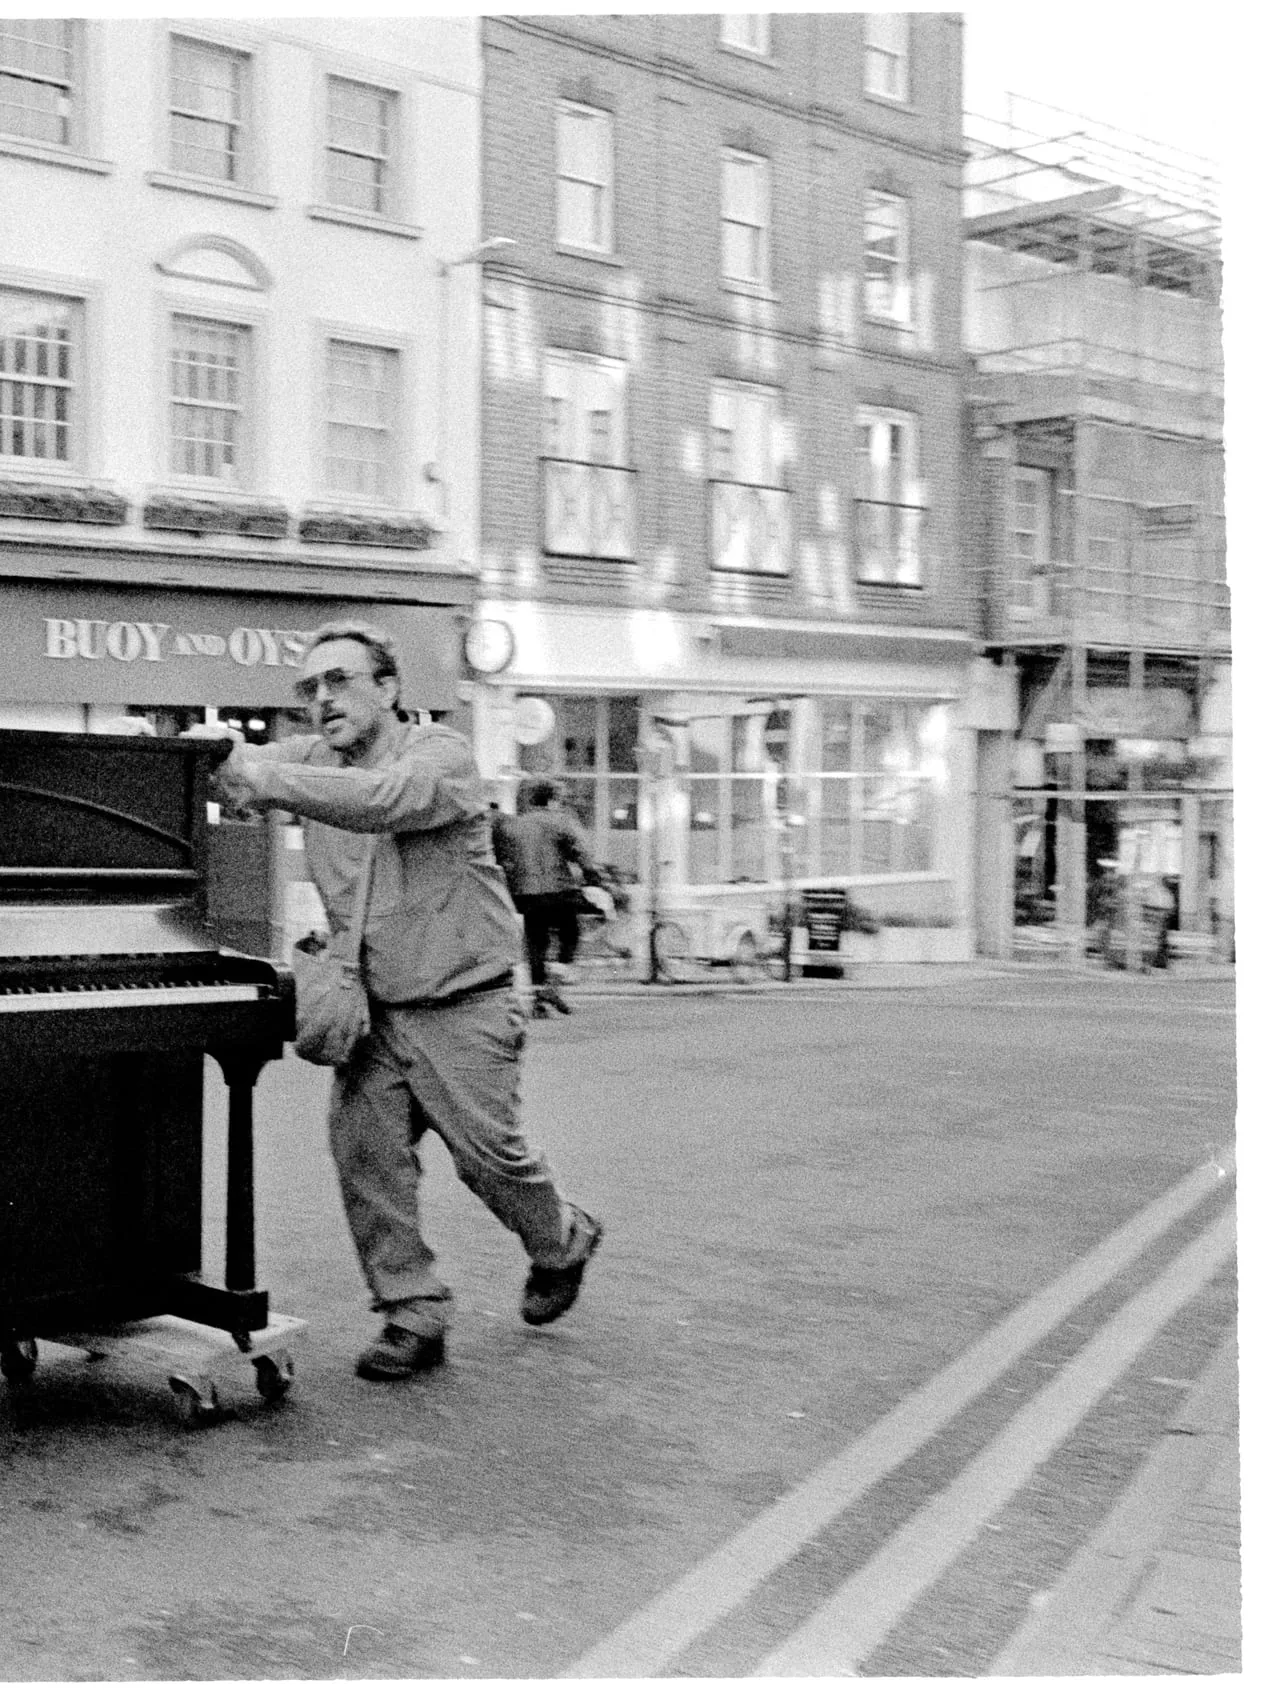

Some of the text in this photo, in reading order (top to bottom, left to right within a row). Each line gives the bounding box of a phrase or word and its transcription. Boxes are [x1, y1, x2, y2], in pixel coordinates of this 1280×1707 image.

[43, 617, 315, 668] BUOY AND OYS
